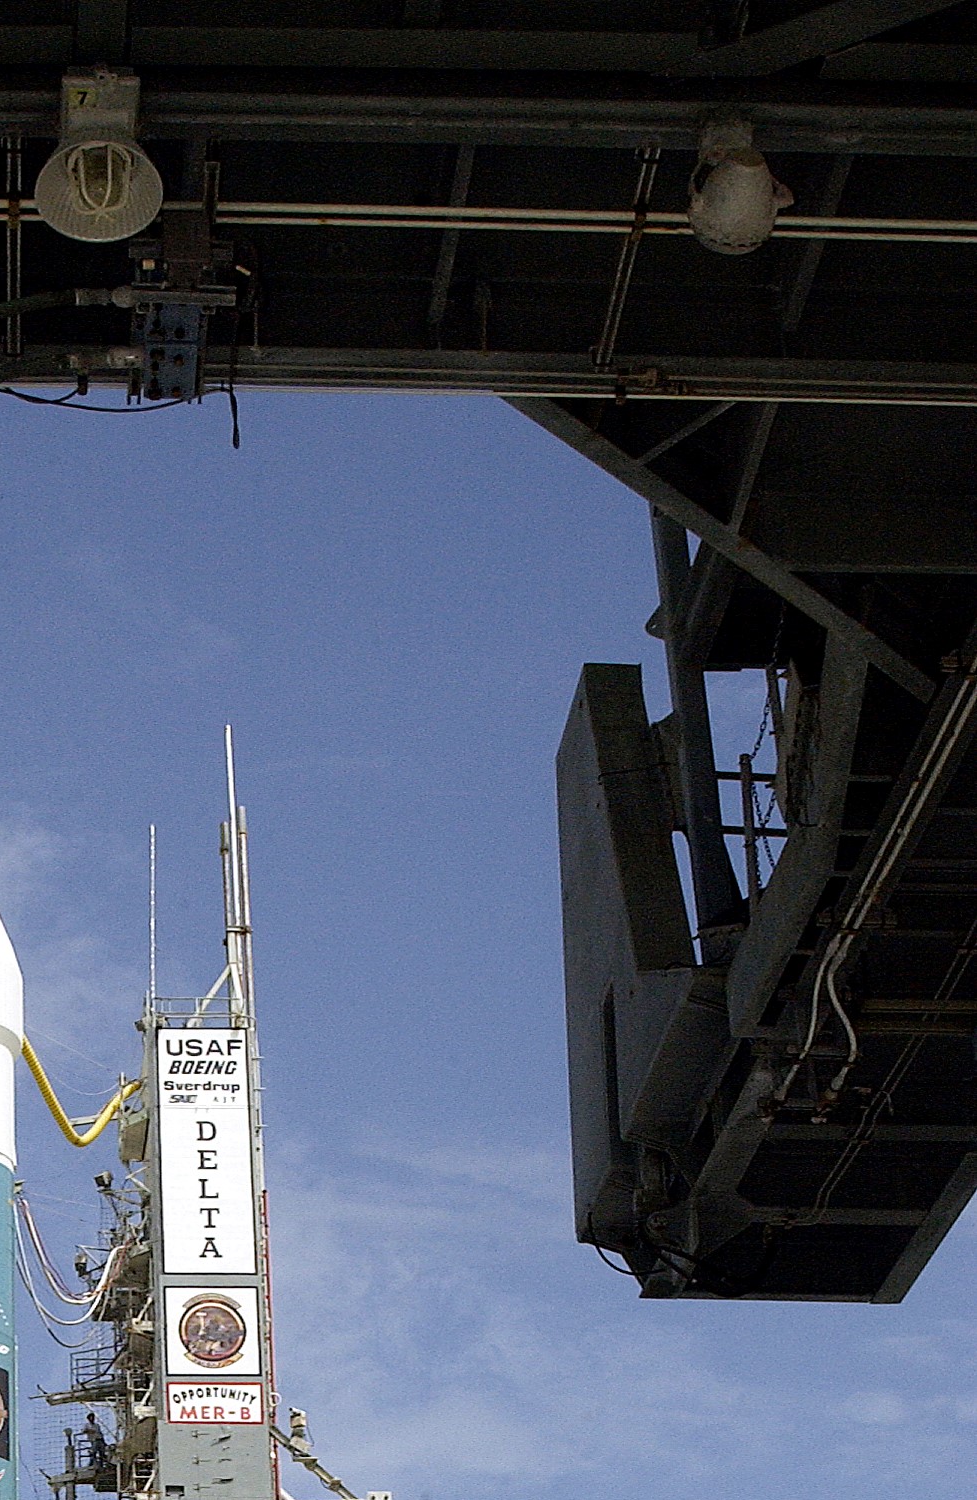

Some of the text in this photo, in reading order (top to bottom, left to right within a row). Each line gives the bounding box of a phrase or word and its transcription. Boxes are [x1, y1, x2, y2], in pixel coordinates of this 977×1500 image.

[77, 91, 88, 105] 7
[165, 1038, 243, 1057] USAF
[168, 1060, 238, 1075] BOEING
[163, 1080, 241, 1094] Sverdrup
[195, 1120, 223, 1259] DELTA
[172, 1386, 257, 1404] OPPORTUNITY
[179, 1406, 252, 1420] MER-B
